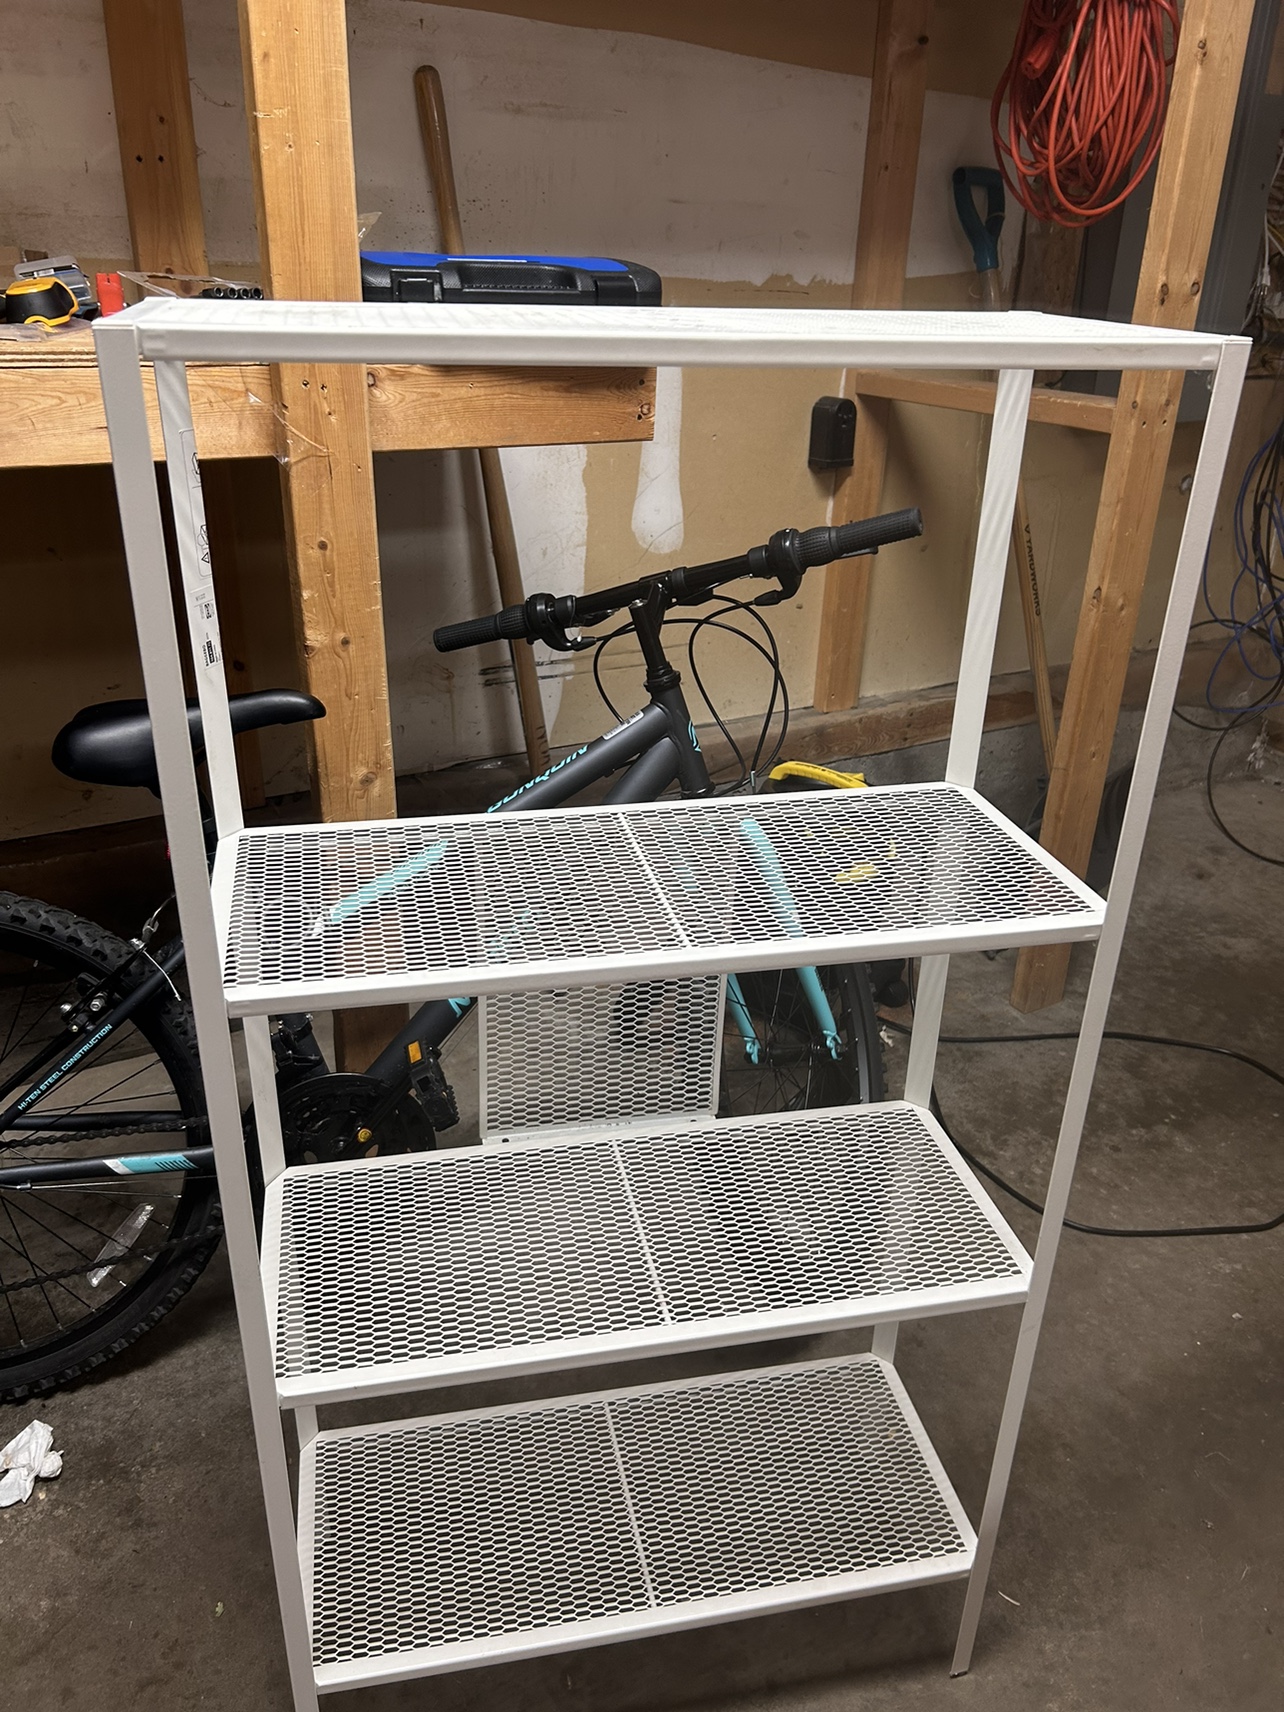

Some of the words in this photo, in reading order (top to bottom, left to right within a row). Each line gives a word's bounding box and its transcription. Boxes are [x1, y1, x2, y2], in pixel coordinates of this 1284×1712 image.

[18, 1089, 41, 1110] HI-TEN
[40, 1070, 63, 1092] STEEL
[61, 1024, 112, 1071] CONSTRUCTION
